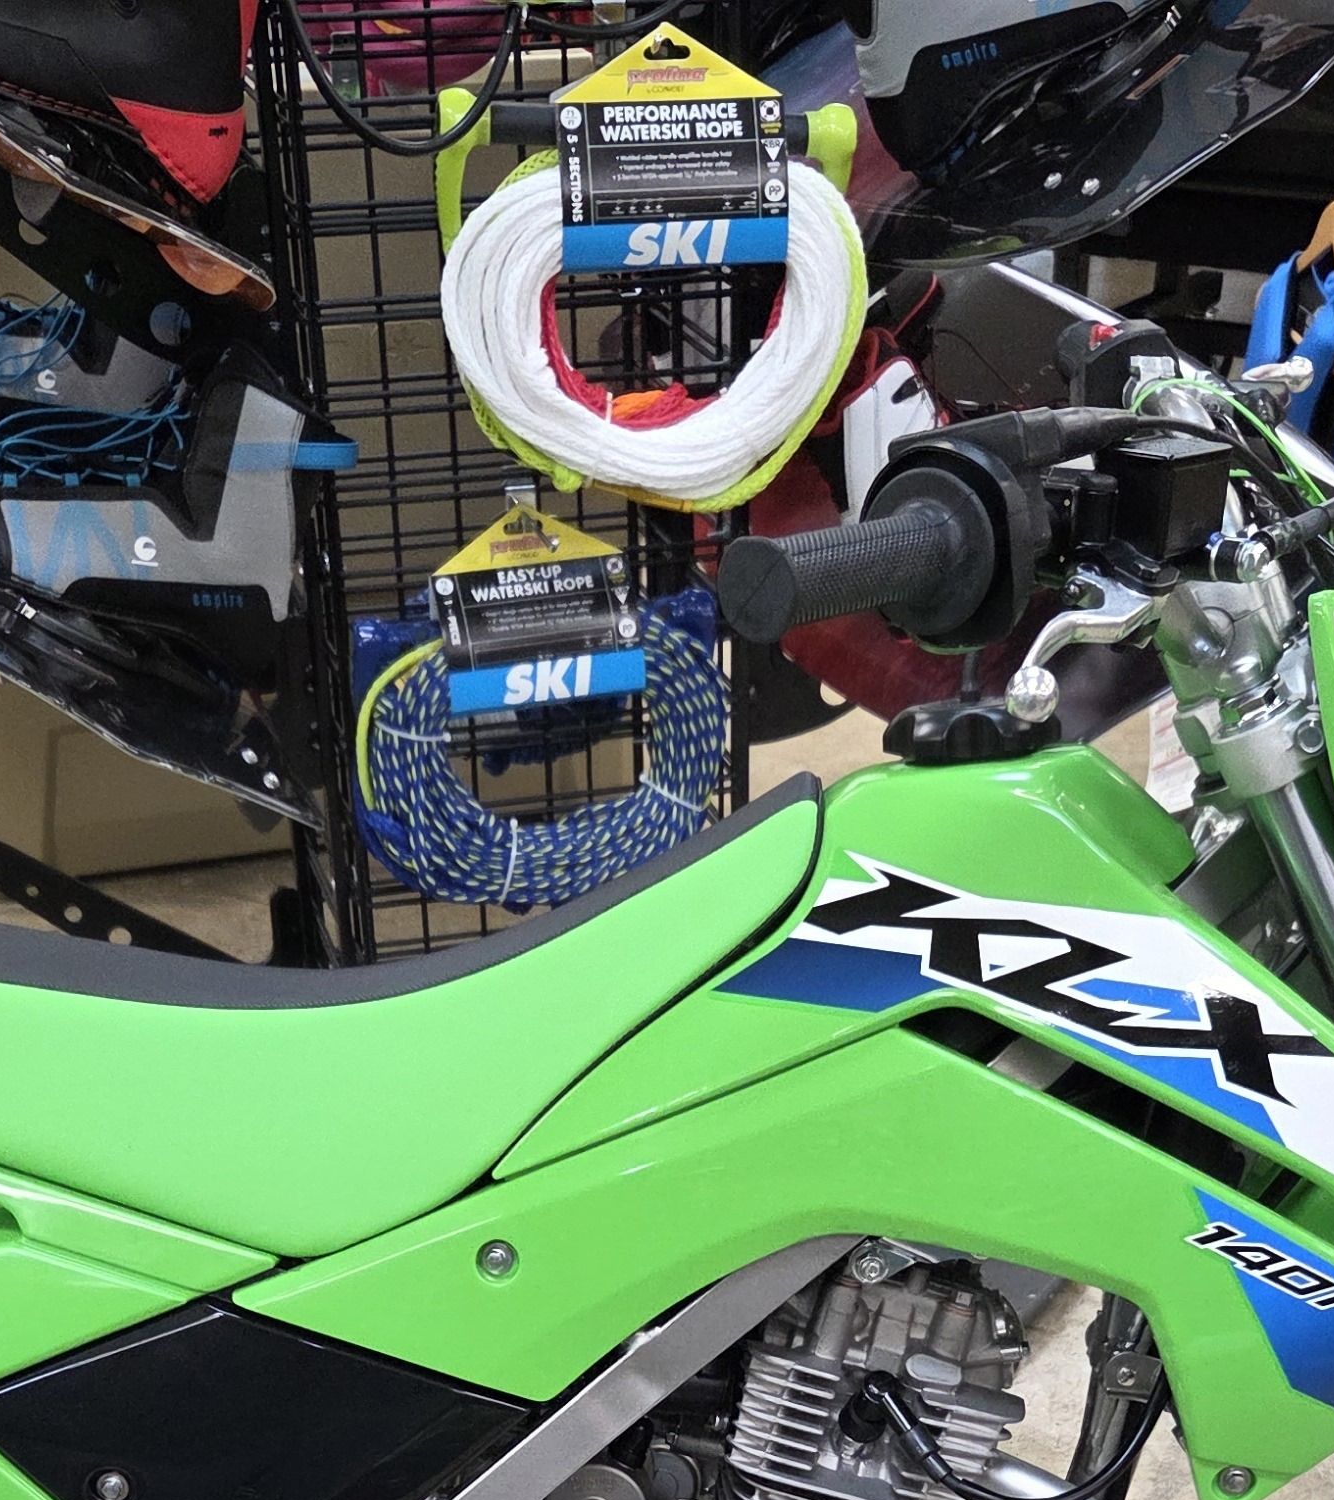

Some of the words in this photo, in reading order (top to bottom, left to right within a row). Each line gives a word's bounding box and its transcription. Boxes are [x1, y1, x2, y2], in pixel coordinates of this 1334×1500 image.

[603, 102, 738, 124] PERFORMANCE
[567, 134, 578, 144] 5
[600, 124, 690, 142] WATERSKI
[696, 120, 743, 138] ROPE
[568, 157, 584, 223] SECTIONS
[769, 185, 781, 196] PP
[623, 219, 731, 266] SKI
[496, 565, 562, 585] EASY-UP
[471, 583, 549, 603] WATERSKI
[553, 575, 595, 593] ROPE
[503, 655, 592, 705] SKI
